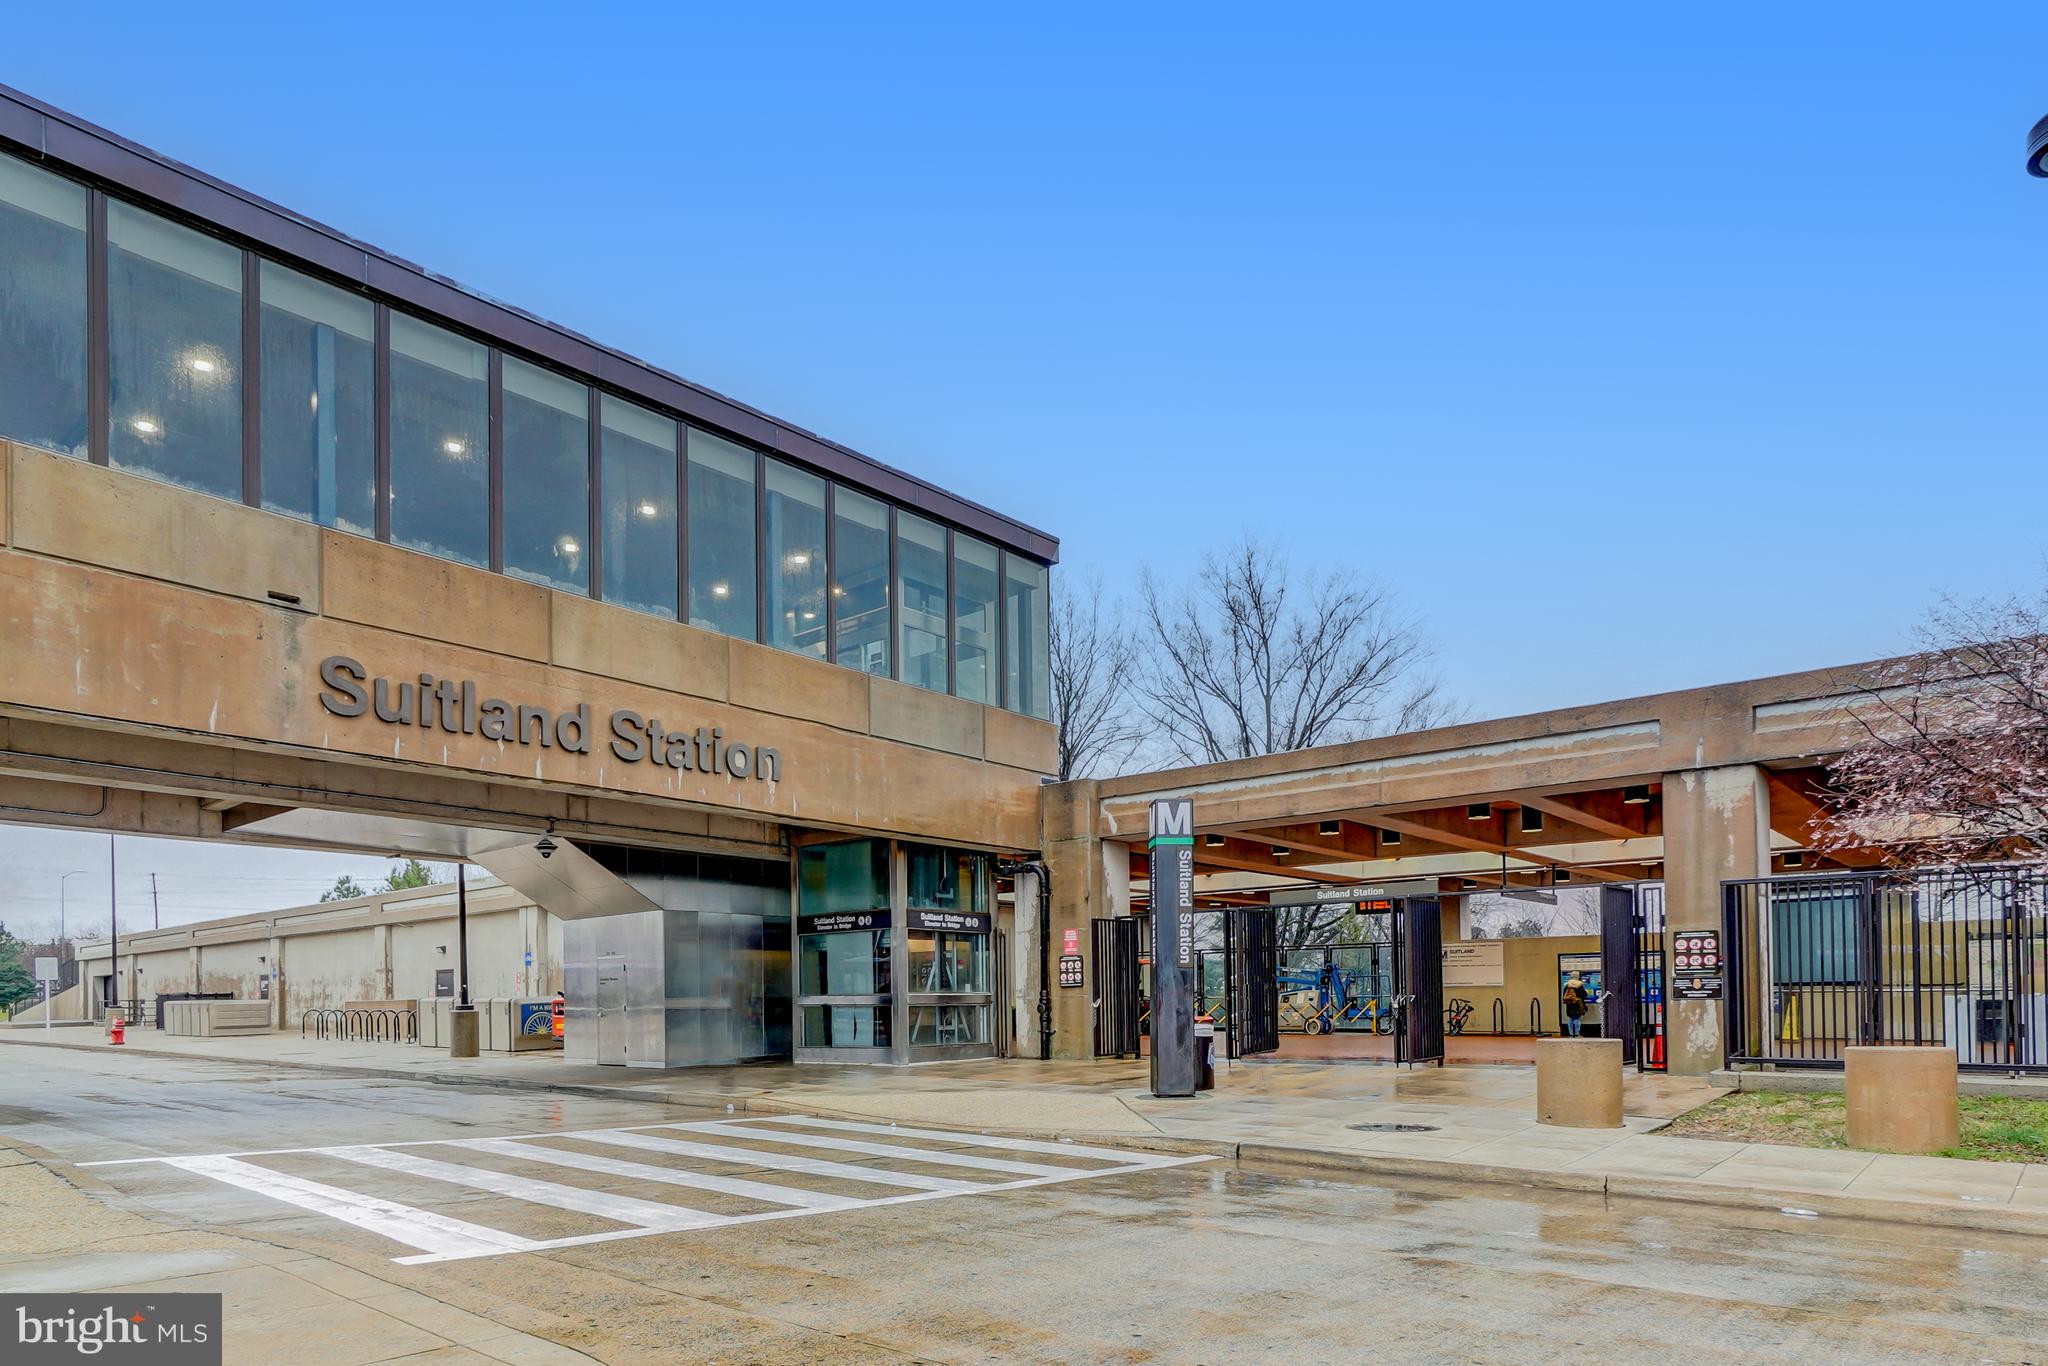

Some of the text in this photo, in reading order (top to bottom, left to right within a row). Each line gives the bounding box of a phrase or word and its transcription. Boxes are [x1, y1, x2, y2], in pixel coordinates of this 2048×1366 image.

[319, 655, 780, 782] Suitland Station
[1157, 802, 1191, 835] M
[1316, 887, 1384, 900] Suitland Station
[920, 912, 964, 923] Suitland Station
[1179, 850, 1192, 964] Suitland Station
[813, 915, 856, 925] Suitland Station
